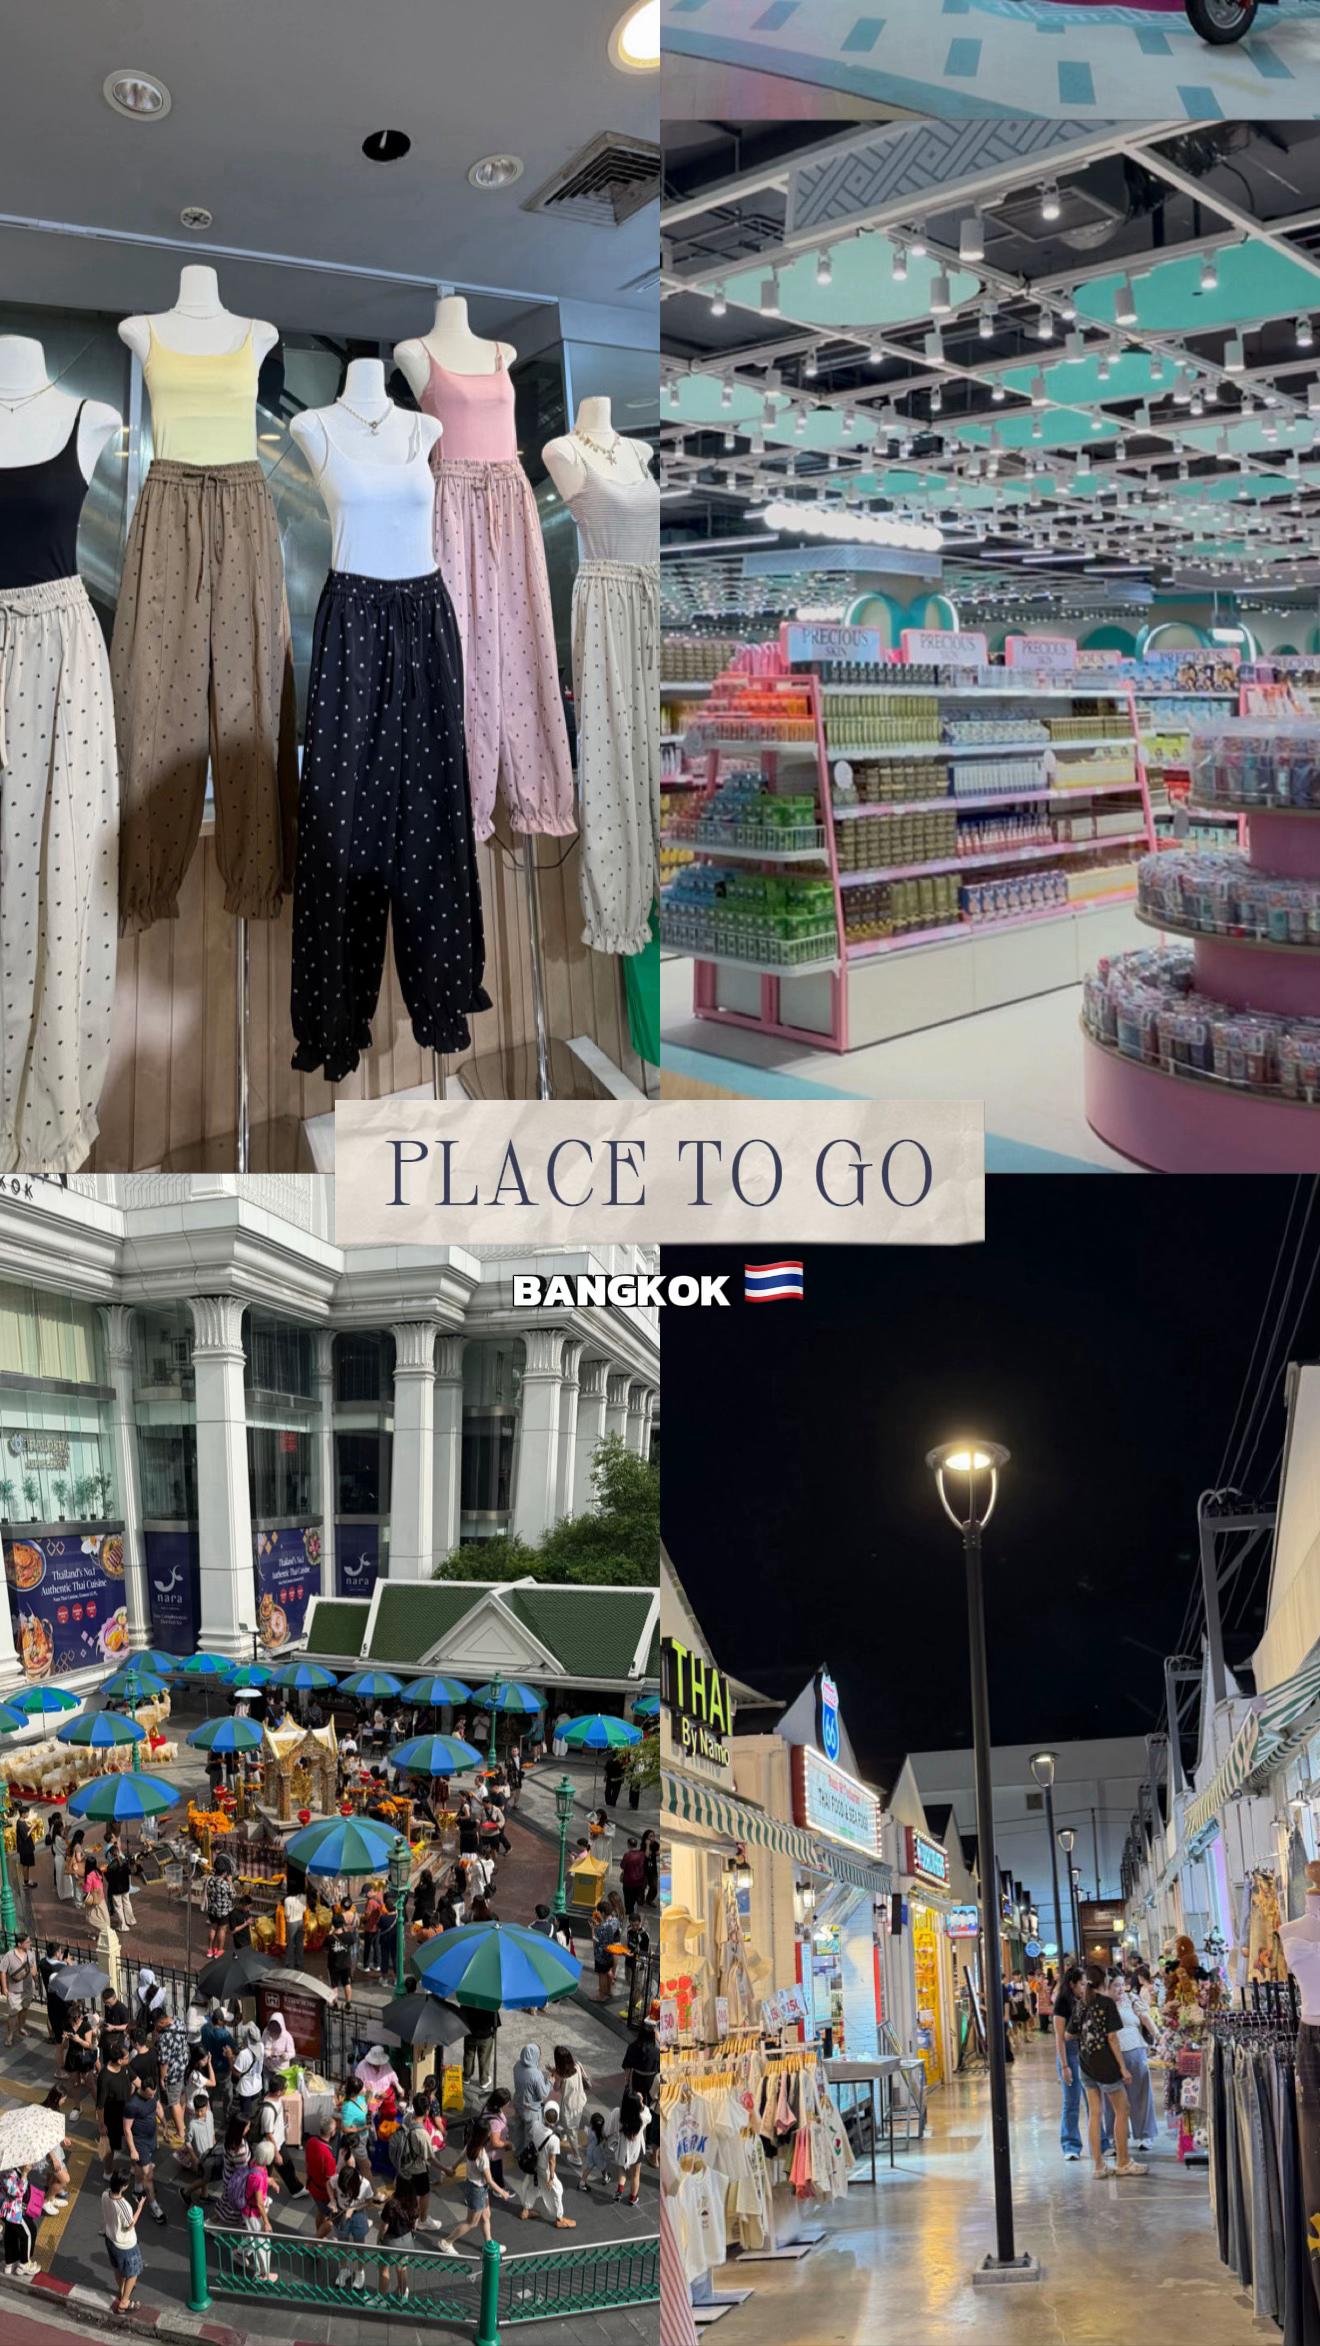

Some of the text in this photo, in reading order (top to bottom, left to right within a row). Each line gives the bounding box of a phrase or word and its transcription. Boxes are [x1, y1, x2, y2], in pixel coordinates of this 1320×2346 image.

[802, 628, 869, 646] PRECIOUS
[920, 634, 976, 650] PRECIOUS
[826, 647, 848, 657] SKIN
[1022, 640, 1068, 655] PRECIOUS
[52, 1568, 83, 1580] Thailand's
[346, 1577, 370, 1586] nara
[41, 1583, 71, 1596] Authentic
[72, 1580, 86, 1591] Thai
[86, 1579, 107, 1589] Cuisine
[157, 1594, 183, 1604] nara
[671, 1638, 732, 1737] THAI
[825, 1713, 837, 1750] 66
[682, 1716, 730, 1767] By Namo
